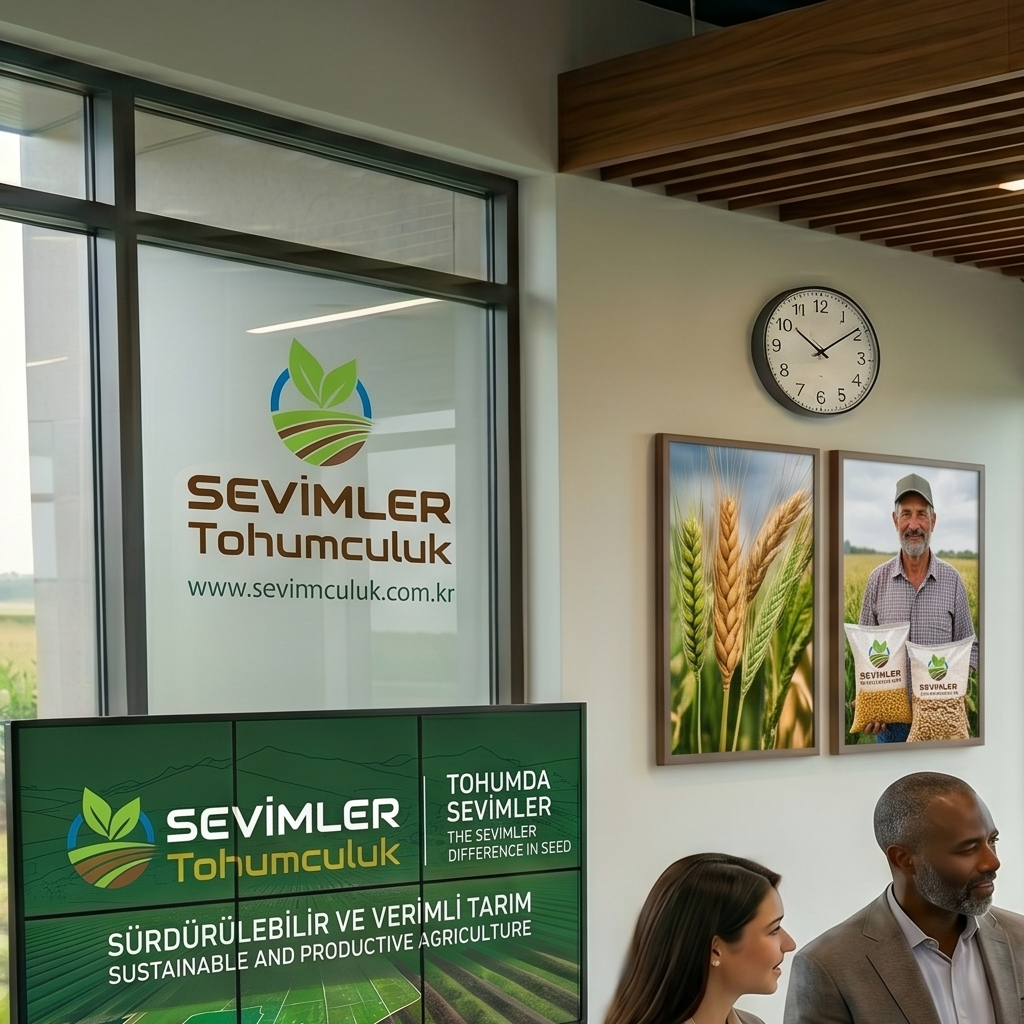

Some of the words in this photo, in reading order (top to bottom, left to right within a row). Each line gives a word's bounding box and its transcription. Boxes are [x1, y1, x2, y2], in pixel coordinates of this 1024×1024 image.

[813, 299, 829, 314] 12
[776, 317, 793, 332] 10
[853, 329, 862, 342] 2
[771, 338, 782, 352] 9
[857, 351, 866, 366] 3
[780, 362, 789, 377] 8
[851, 373, 862, 387] 4
[795, 382, 805, 397] 7
[816, 390, 826, 404] 6
[837, 388, 846, 402] 5
[187, 474, 452, 525] SEVİMLER
[188, 521, 452, 565] Tohumculuk
[446, 769, 551, 795] TOHUMDA
[447, 794, 552, 823] SEVİMLER
[166, 795, 401, 843] SEVİMLER
[447, 829, 473, 844] THE
[448, 843, 524, 862] DIFFERENCE
[526, 842, 539, 856] IN
[541, 839, 572, 855] SEED
[166, 836, 401, 883] Tohumculuk
[108, 907, 330, 957] SÜRDÜRÜLEBİLİR
[335, 908, 365, 933] VE
[371, 893, 461, 929] VERİMLİ
[466, 891, 532, 918] TARIM
[108, 951, 249, 985] SUSTAINABLE
[254, 946, 295, 968] AND
[300, 932, 414, 963] PRODUCTIVE
[418, 919, 532, 949] AGRICULTURE
